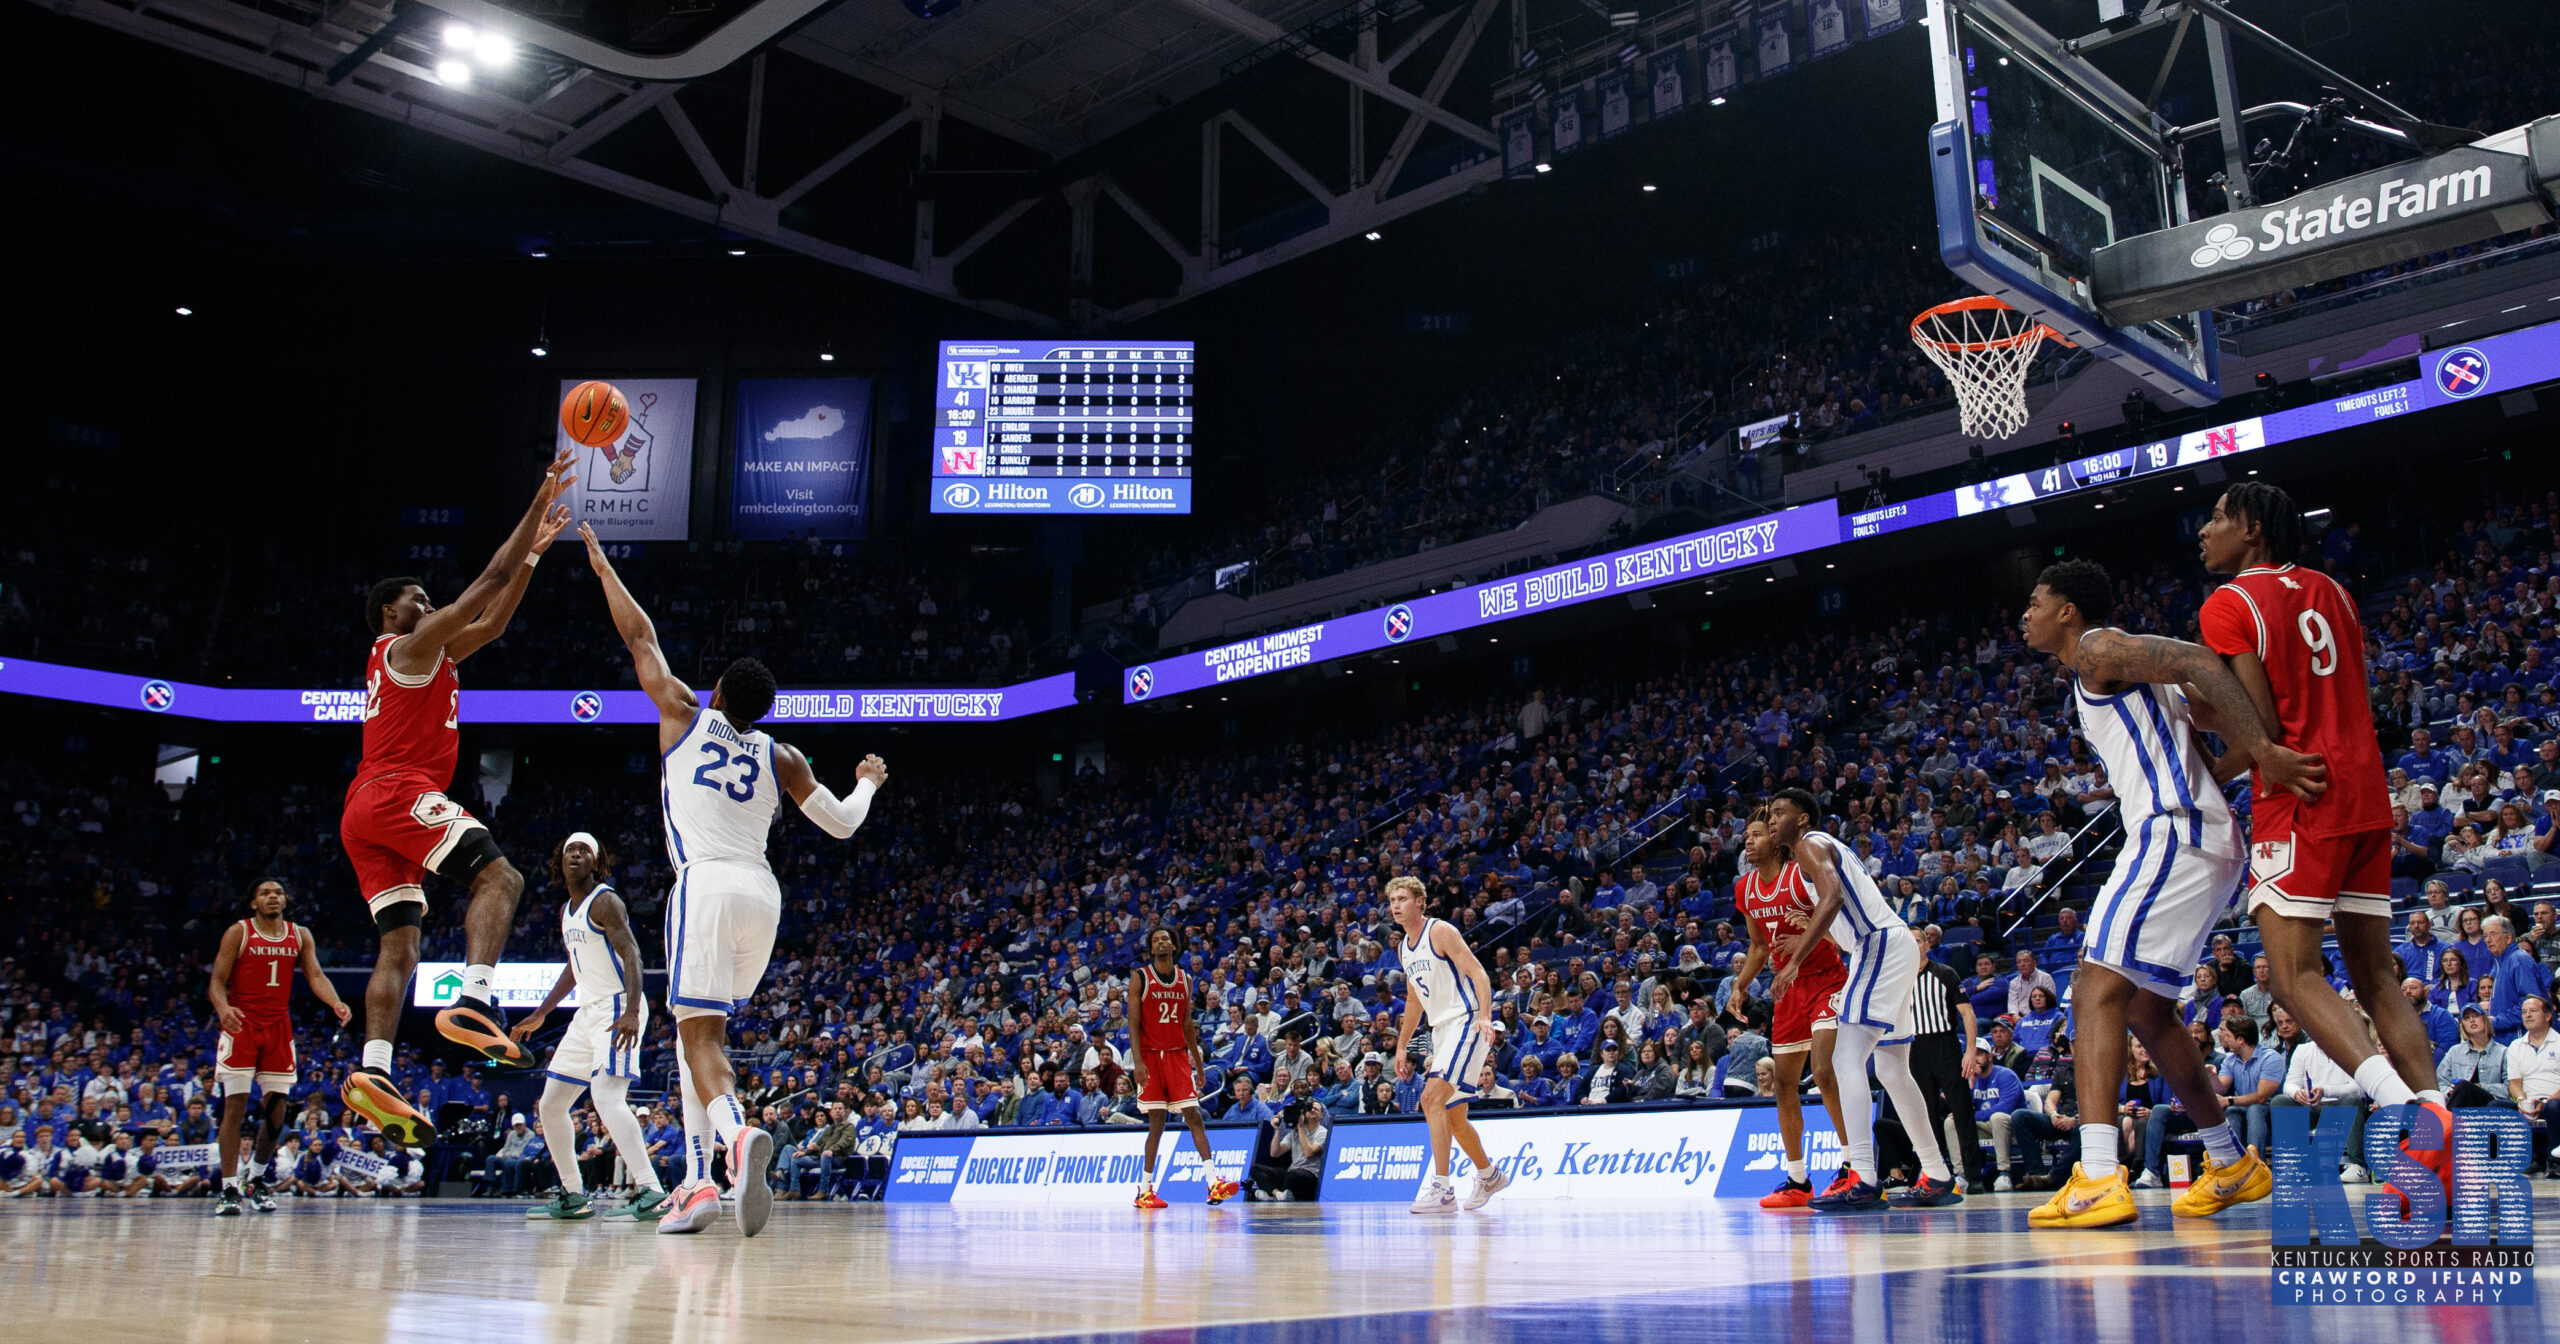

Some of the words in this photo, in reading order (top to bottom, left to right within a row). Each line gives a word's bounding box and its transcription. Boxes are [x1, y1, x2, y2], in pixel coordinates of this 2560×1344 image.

[1058, 350, 1071, 360] PTS
[1081, 350, 1094, 360] REB
[1105, 350, 1118, 360] AST
[1129, 350, 1142, 360] BLK
[1153, 350, 1165, 360] STL
[1176, 350, 1188, 360] FLS
[954, 390, 969, 406] 41
[2335, 393, 2378, 414] TIMEOUTS
[2378, 386, 2408, 404] LEFT:2
[946, 409, 975, 420] 16:00
[952, 430, 967, 445] 19
[2205, 423, 2238, 458] N
[953, 452, 976, 470] N
[2083, 453, 2121, 475] 16:00
[2146, 443, 2168, 469] 19
[744, 461, 782, 472] MAKE
[784, 461, 804, 472] AN
[807, 461, 859, 472] IMPACT.
[2041, 468, 2061, 492] 41
[2089, 472, 2103, 484] 2ND
[2103, 469, 2121, 482] HALF
[786, 489, 814, 500] Visit
[988, 483, 1048, 500] Hilton
[1113, 483, 1173, 500] Hilton
[584, 498, 649, 512] RMHC
[739, 502, 859, 516] rmhclexington.org
[418, 508, 451, 523] 242
[589, 517, 605, 526] the
[607, 517, 654, 527] Bluegrass
[1852, 508, 1885, 526] TIMEOUTS
[1884, 504, 1907, 519] LEFT:3
[408, 545, 446, 559] 242
[1479, 581, 1518, 618] WE
[1524, 561, 1608, 608] BUILD
[1615, 520, 1779, 586] KENTUCKY
[1822, 591, 1843, 610] 13
[1204, 643, 1262, 667] CENTRAL
[1263, 624, 1324, 653] MIDWEST
[2298, 608, 2337, 677] 9
[1216, 644, 1311, 682] CARPENTERS
[301, 691, 367, 705] CENTRAL
[773, 694, 854, 718] BUILD
[861, 692, 1003, 718] KENTUCKY
[693, 741, 760, 803] 23
[1749, 904, 1793, 920] NICHOLLS
[1765, 920, 1778, 946] 7
[248, 946, 298, 957] NICHOLLS
[573, 947, 582, 973] 1
[266, 960, 280, 987] 1
[1151, 990, 1185, 1000] NICHOLLS
[1416, 976, 1430, 998] 5
[1158, 1002, 1179, 1024] 24
[155, 1148, 209, 1165] DEFENSE
[337, 1146, 385, 1174] DEFENSE
[900, 1156, 930, 1170] BUCKLE
[933, 1155, 959, 1169] PHONE
[1215, 1149, 1248, 1166] PHONE
[1338, 1146, 1381, 1163] BUCKLE
[1387, 1145, 1425, 1162] PHONE
[1554, 1136, 1716, 1186] Kentucky.
[914, 1170, 926, 1184] UP
[929, 1170, 955, 1184] DOWN
[967, 1156, 1021, 1185] BUCKLE
[1024, 1155, 1046, 1184] UP
[1054, 1154, 1105, 1184] PHONE
[1361, 1164, 1378, 1180] UP
[1384, 1163, 1421, 1180] DOWN
